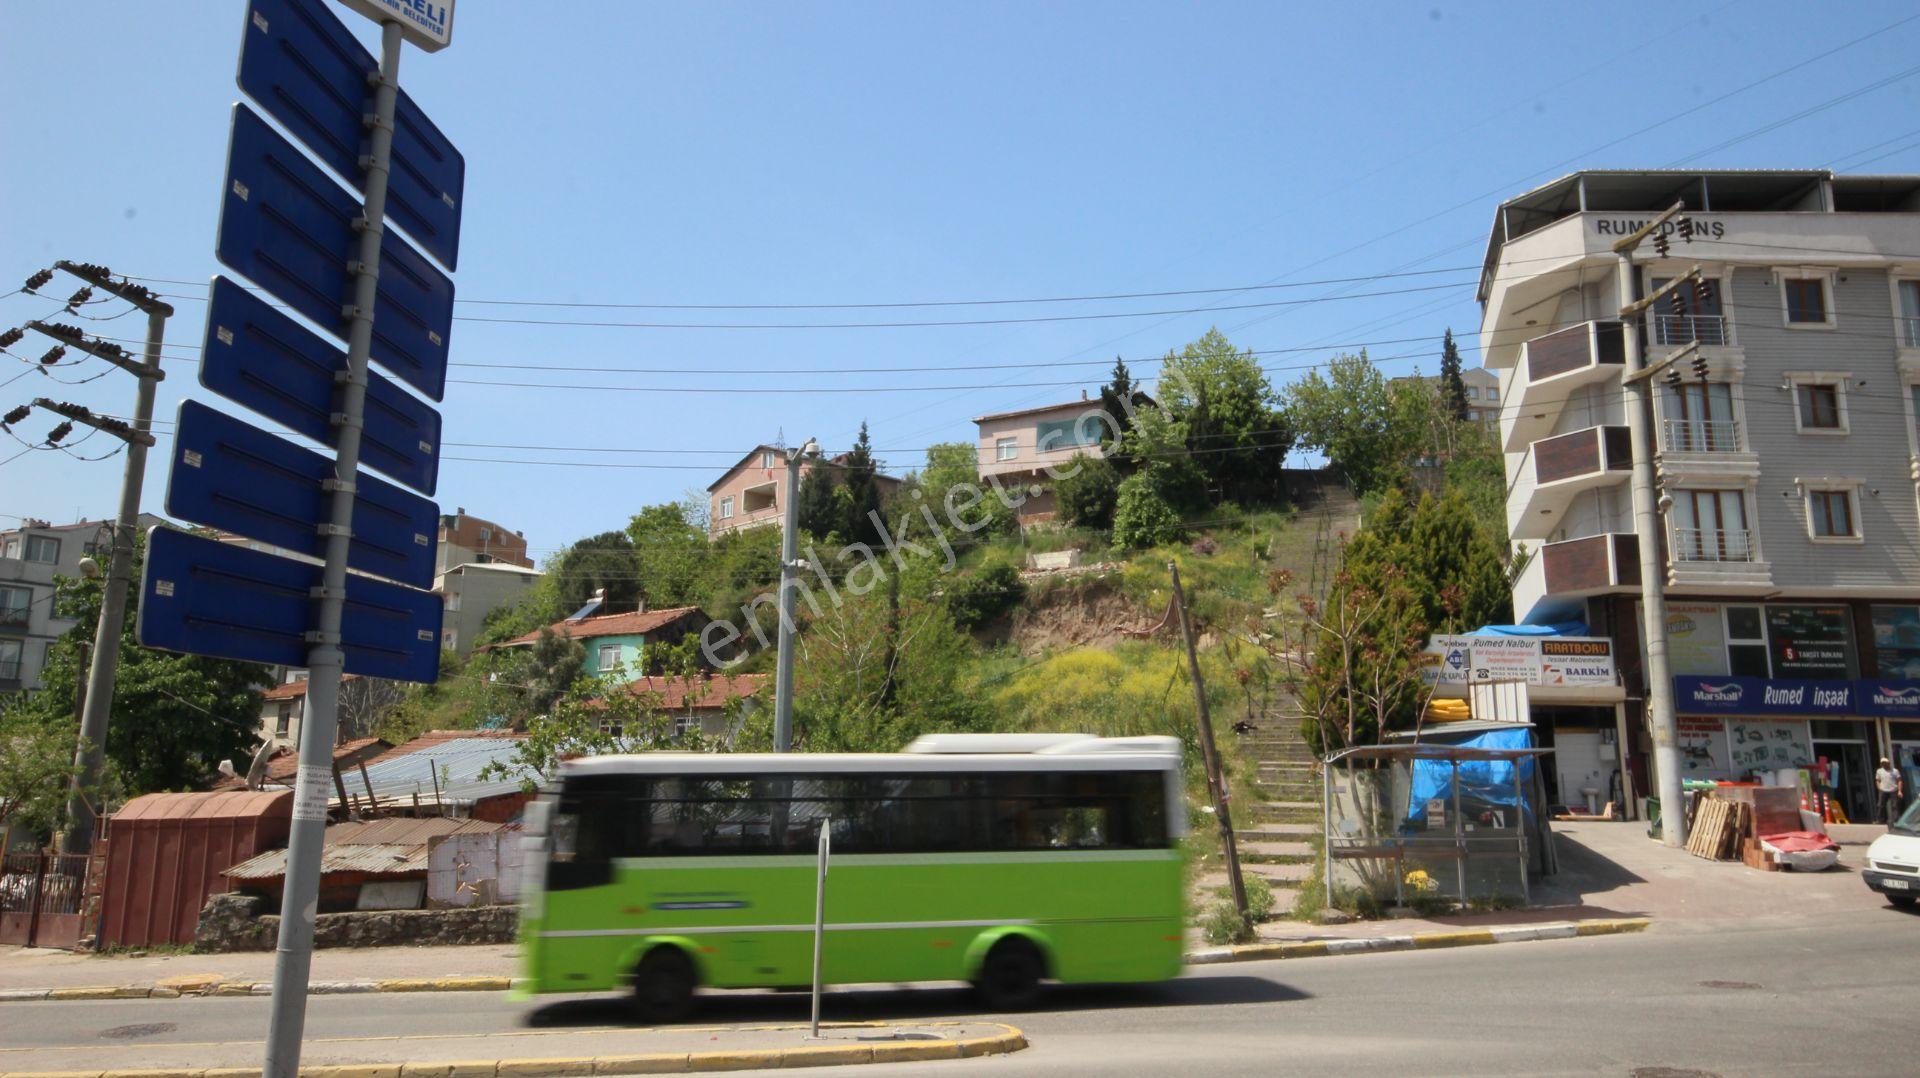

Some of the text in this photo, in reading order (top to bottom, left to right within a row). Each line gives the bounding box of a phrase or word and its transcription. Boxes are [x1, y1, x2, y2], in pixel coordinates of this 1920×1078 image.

[403, 7, 444, 36] BELEDİYESİ
[1473, 639, 1535, 649] Rumed Nalbur
[1544, 642, 1606, 654] FIRATBORU
[1566, 667, 1609, 676] BARKİM
[1693, 690, 1738, 701] Marshall
[1764, 686, 1849, 708] Rumed inşaat
[1873, 694, 1918, 705] Marshall
